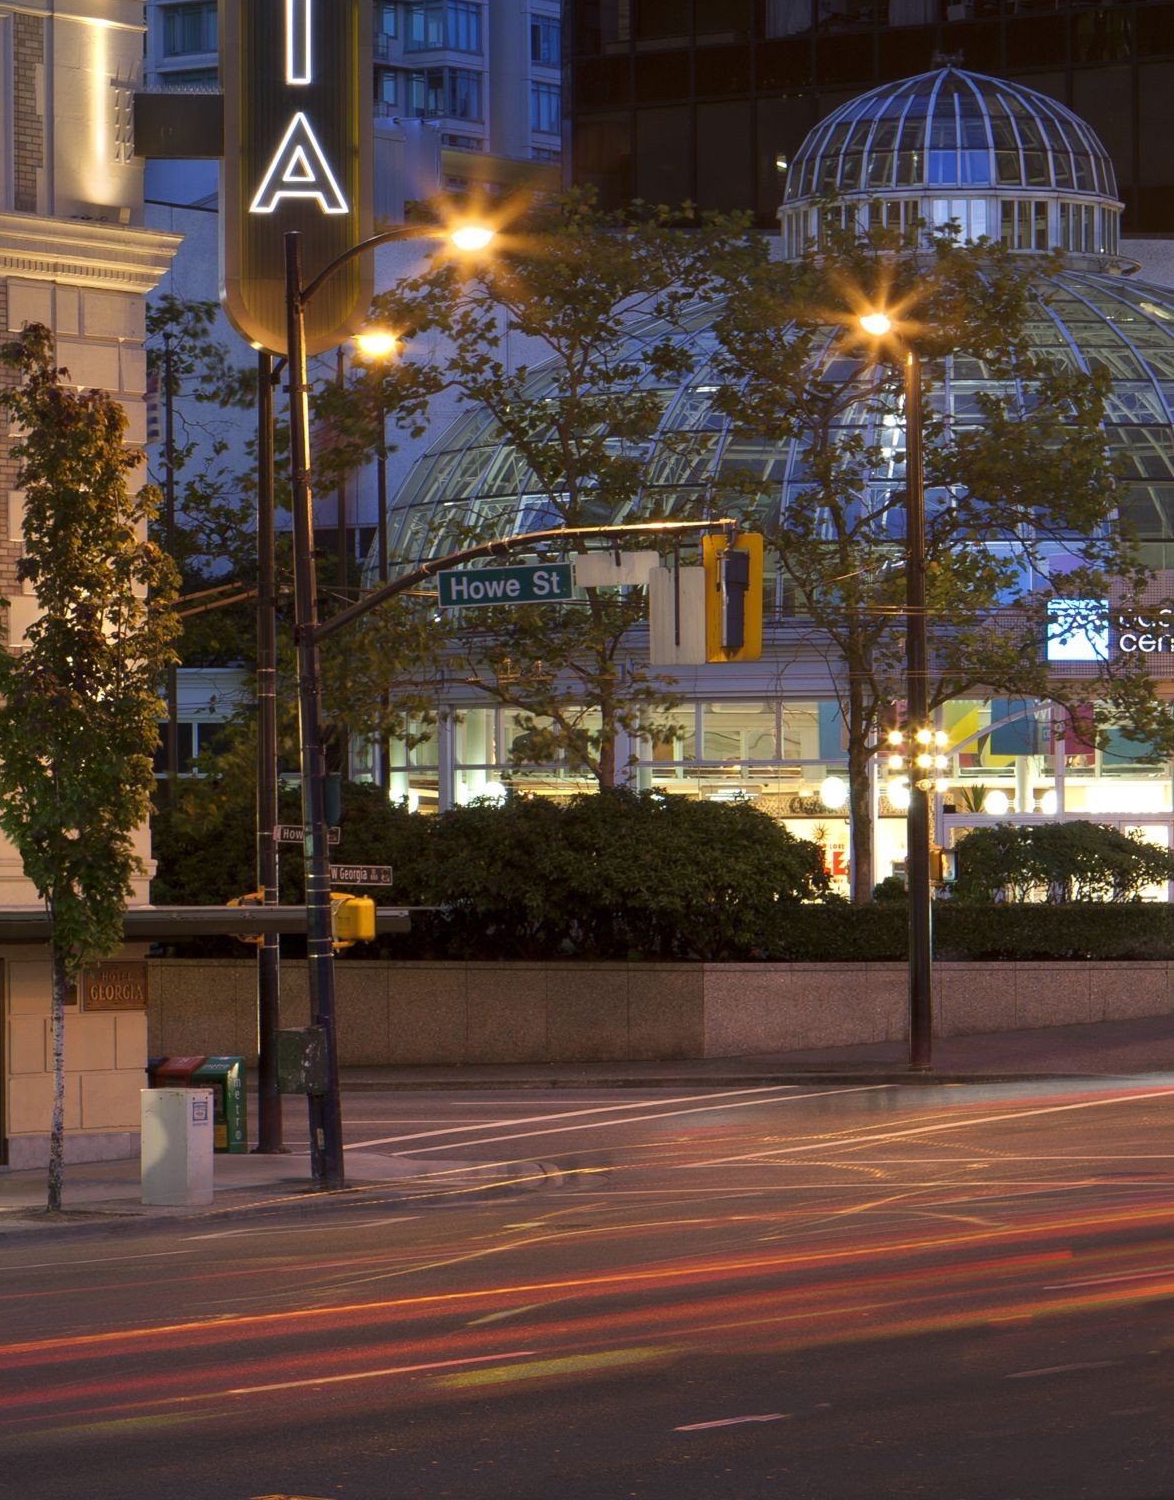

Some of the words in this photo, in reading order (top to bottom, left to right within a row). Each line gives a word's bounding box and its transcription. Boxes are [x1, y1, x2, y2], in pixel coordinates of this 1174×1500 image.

[450, 576, 521, 600] Howe
[532, 570, 561, 595] St
[282, 828, 305, 840] How
[330, 867, 338, 879] W
[339, 867, 368, 883] Georgia
[102, 971, 134, 981] HOTEL
[90, 984, 144, 1001] GEORGIA
